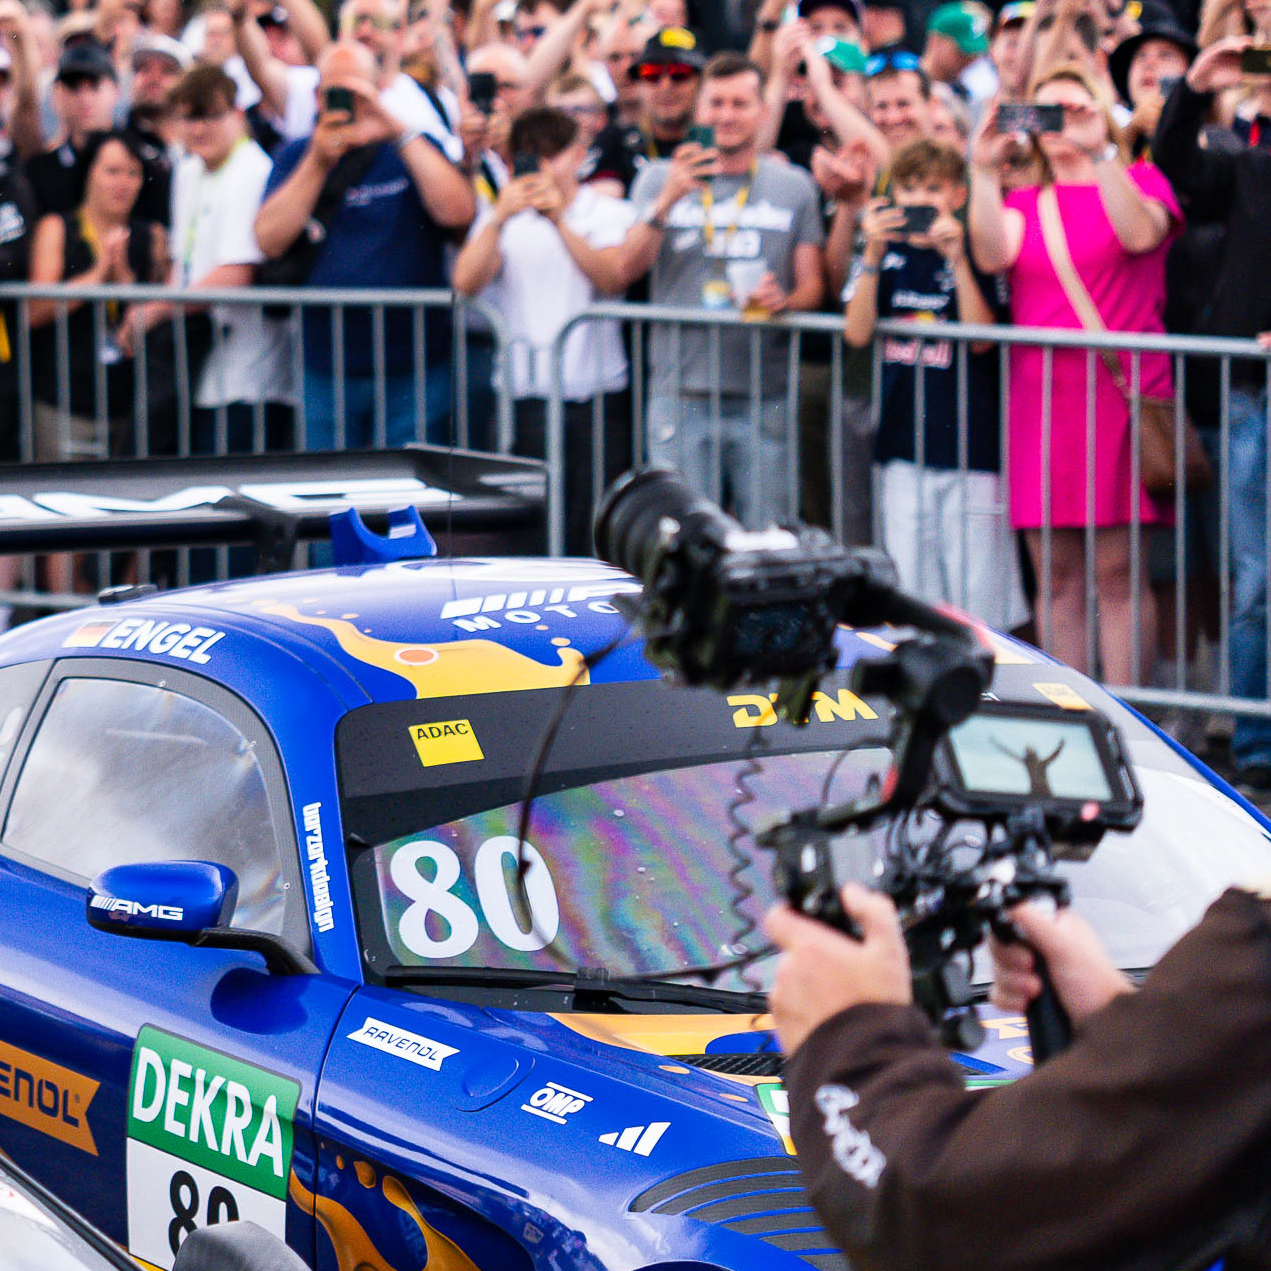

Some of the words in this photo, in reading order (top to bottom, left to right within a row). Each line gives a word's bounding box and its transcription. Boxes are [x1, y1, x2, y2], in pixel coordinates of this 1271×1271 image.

[98, 617, 228, 665] ENGEL
[415, 722, 470, 741] ADAC
[110, 897, 184, 922] AMG
[389, 835, 560, 959] 80
[361, 1025, 444, 1063] RAVENOL
[131, 1045, 285, 1178] DEKRA
[528, 1085, 588, 1118] OMP
